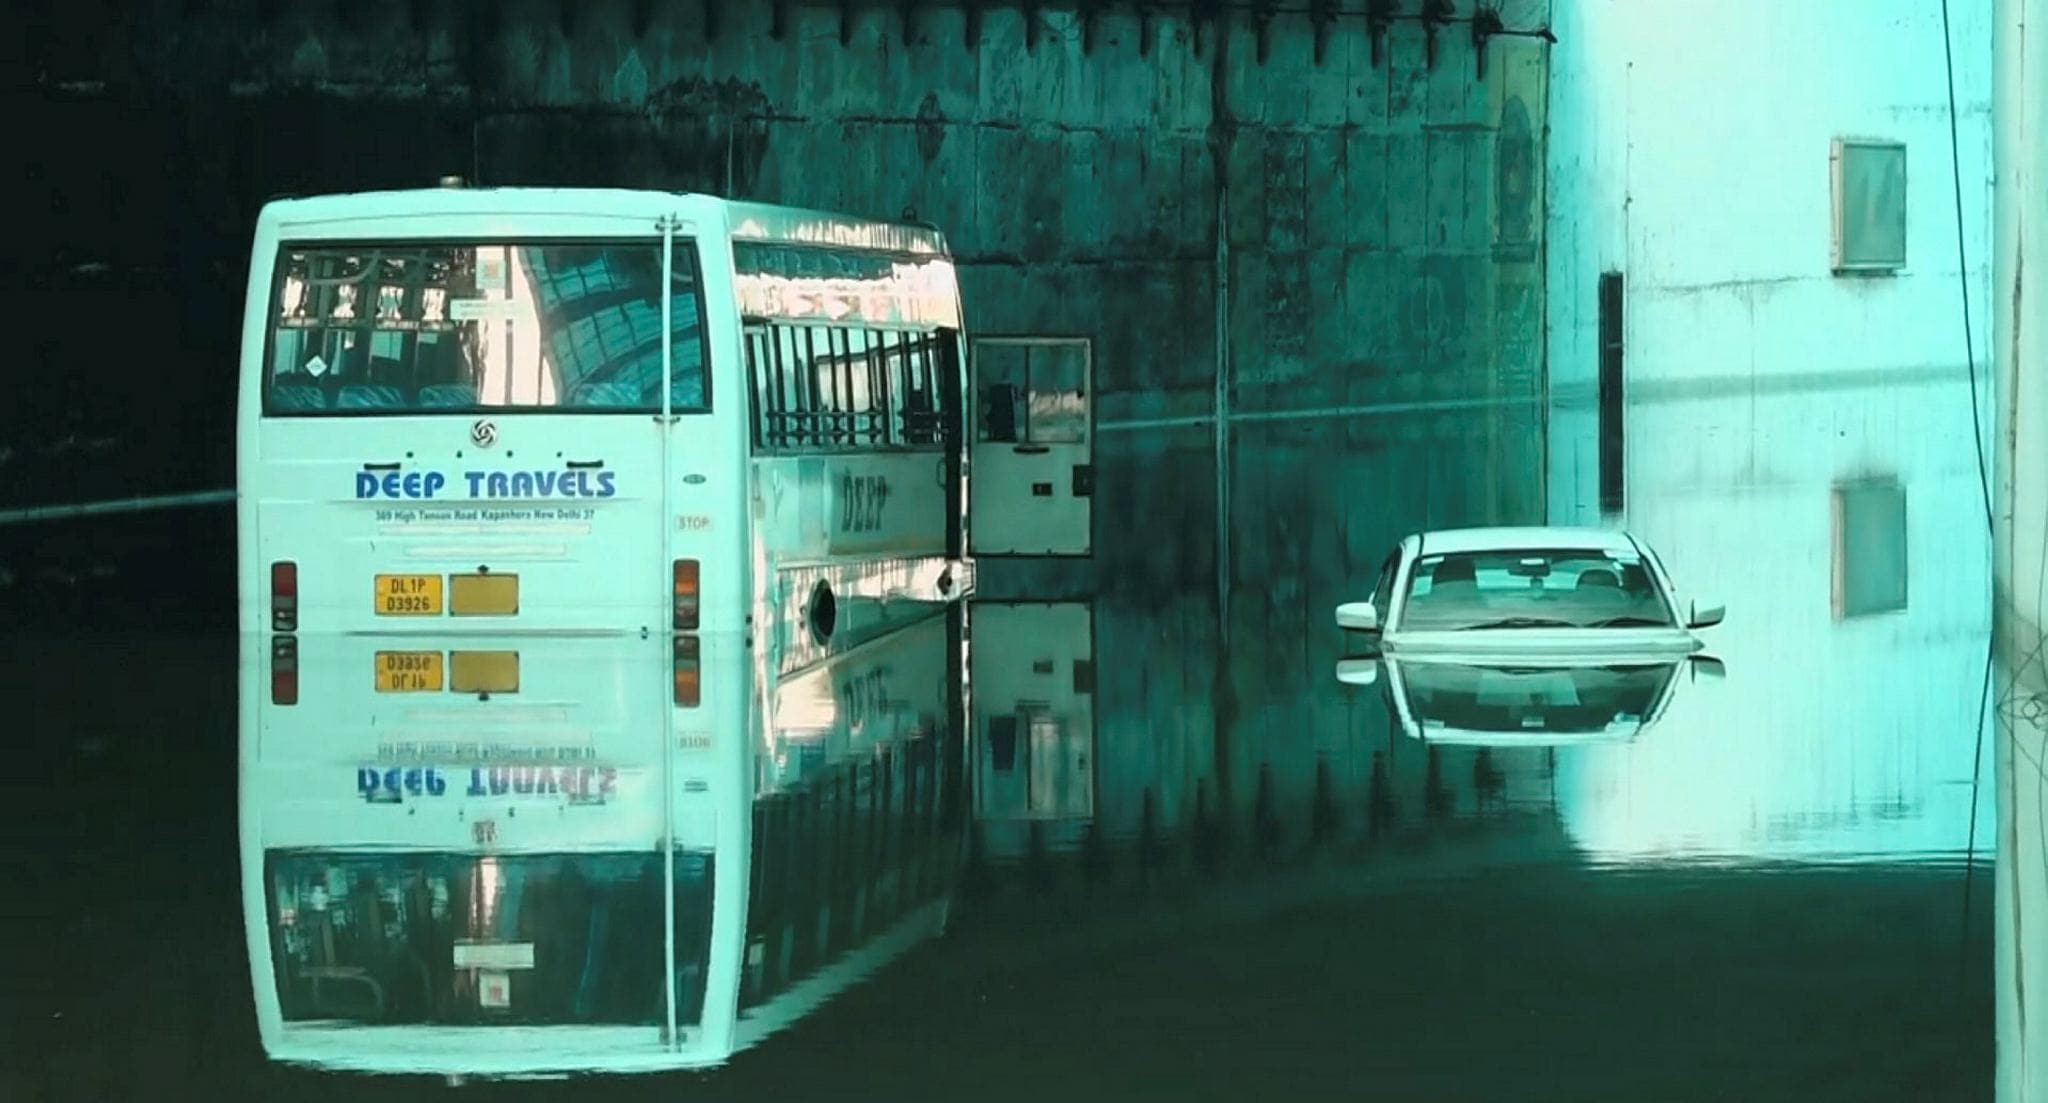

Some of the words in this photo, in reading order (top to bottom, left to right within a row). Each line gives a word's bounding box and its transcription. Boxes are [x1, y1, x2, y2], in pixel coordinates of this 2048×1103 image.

[356, 471, 446, 499] DEEP
[465, 471, 616, 498] TRAVELS
[841, 475, 889, 532] DEEP
[454, 509, 478, 521] Road
[534, 508, 555, 520] New
[557, 508, 581, 520] Delhi
[679, 516, 710, 530] STOP
